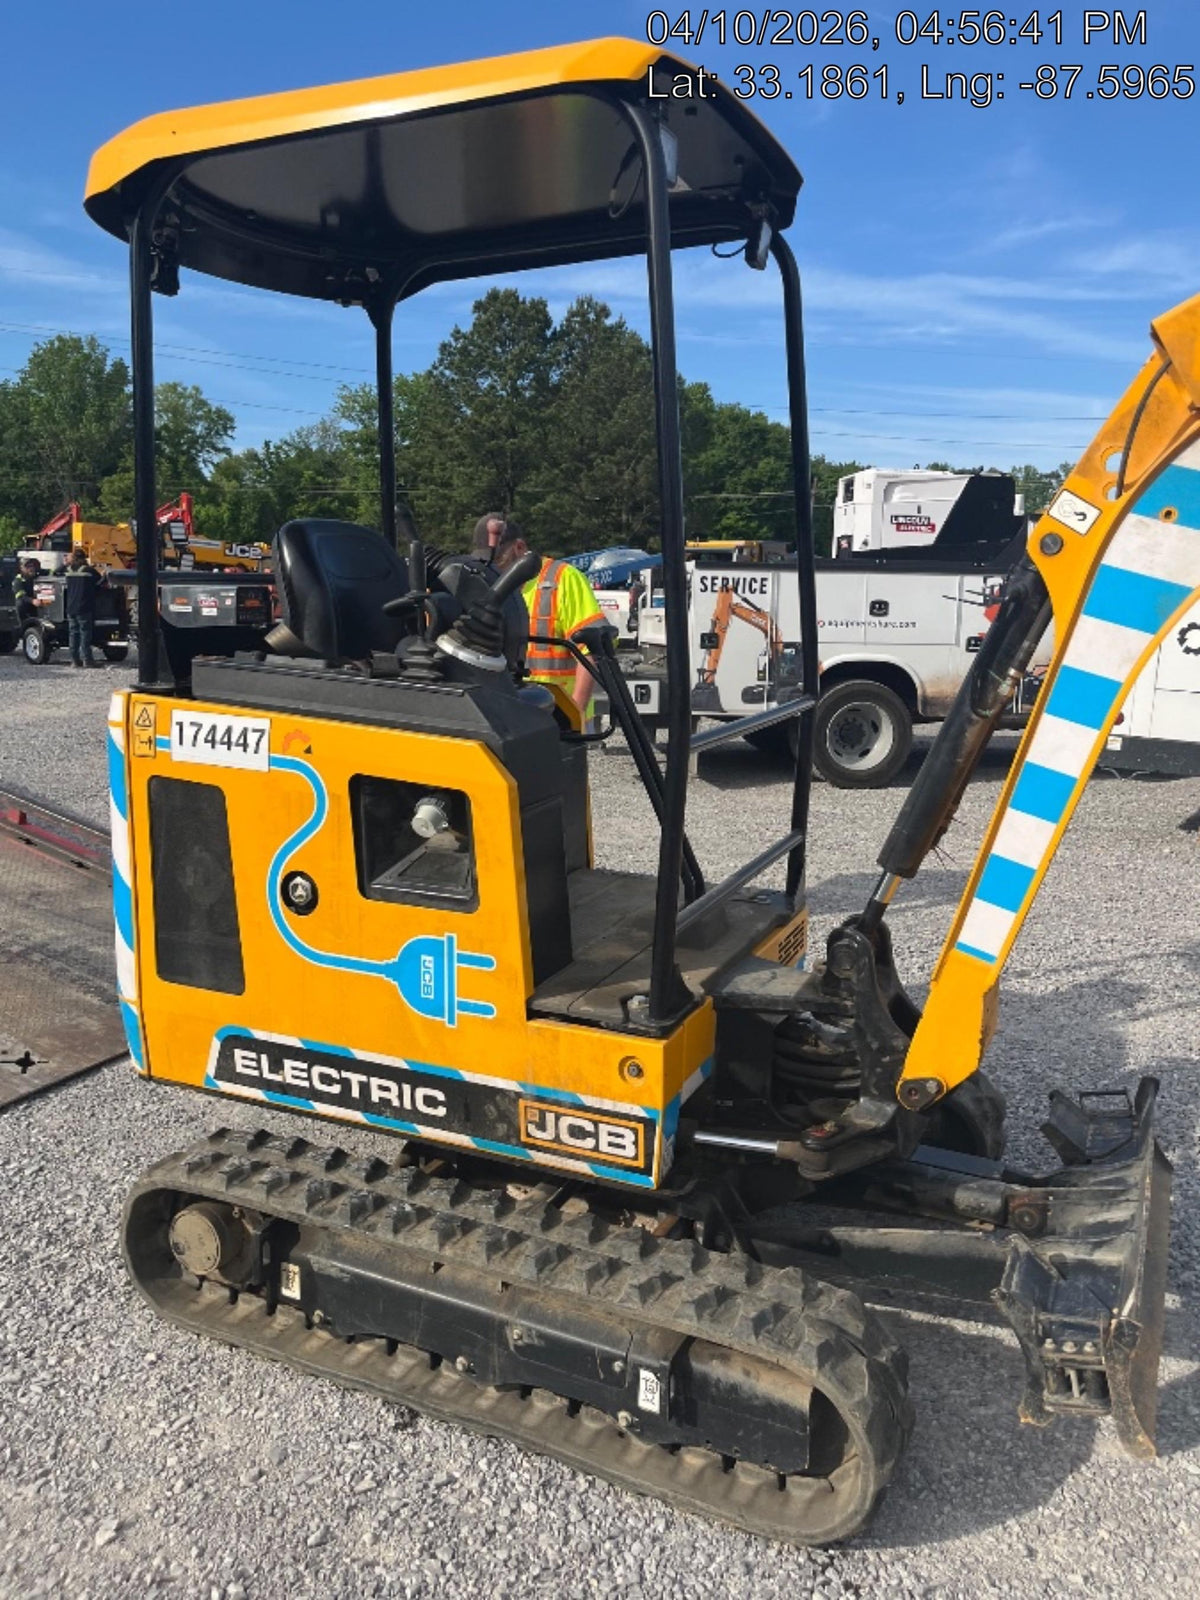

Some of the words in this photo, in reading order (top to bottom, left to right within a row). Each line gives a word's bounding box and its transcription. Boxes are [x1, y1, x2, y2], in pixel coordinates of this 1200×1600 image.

[225, 543, 262, 559] JCB
[700, 576, 769, 595] SERVICE
[175, 721, 266, 755] 174447
[422, 959, 433, 996] JCB
[233, 1048, 447, 1117] ELECTRIC
[526, 1108, 637, 1158] JCB
